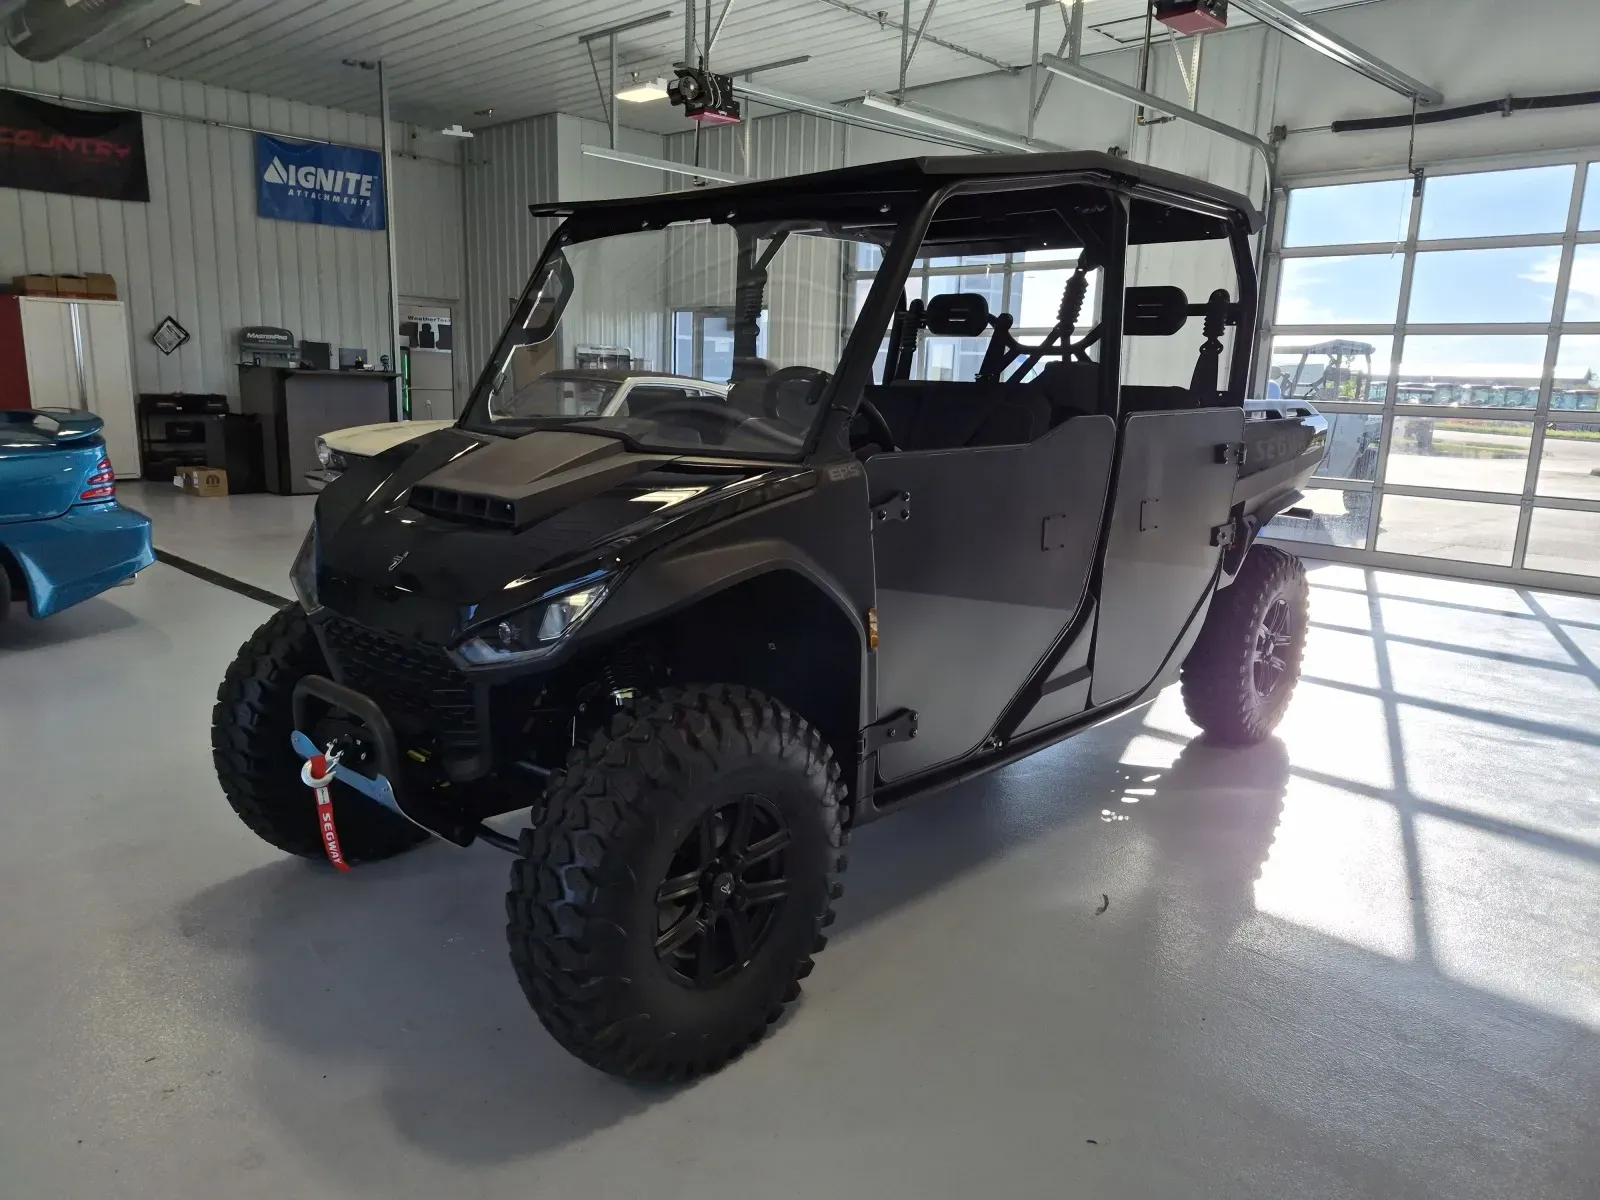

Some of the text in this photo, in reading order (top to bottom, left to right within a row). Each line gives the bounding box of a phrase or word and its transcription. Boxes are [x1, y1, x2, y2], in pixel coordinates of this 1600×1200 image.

[288, 164, 373, 197] IGNITE
[288, 188, 371, 207] ATTACHMENTS
[828, 462, 860, 481] EPS
[322, 812, 342, 864] SEGWAY
